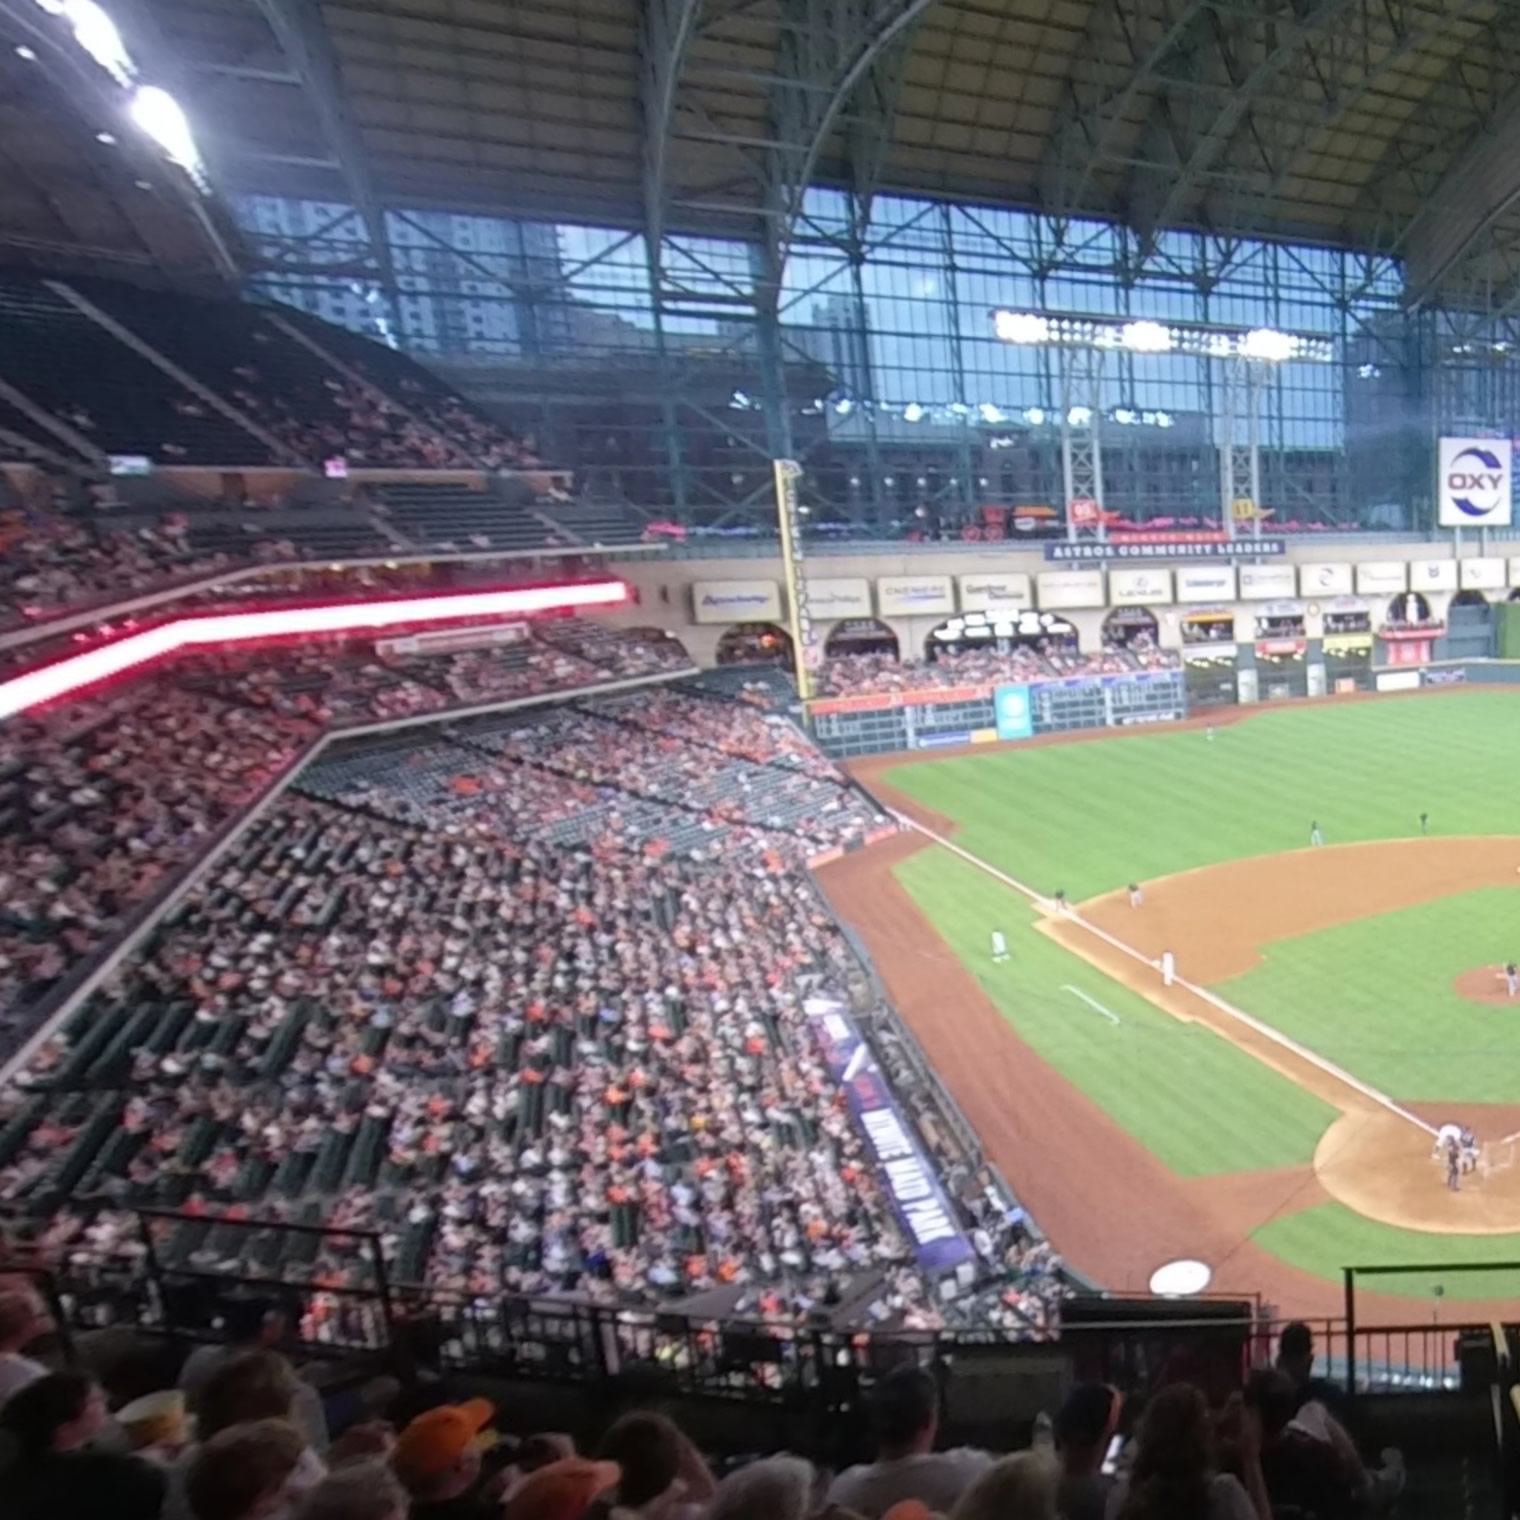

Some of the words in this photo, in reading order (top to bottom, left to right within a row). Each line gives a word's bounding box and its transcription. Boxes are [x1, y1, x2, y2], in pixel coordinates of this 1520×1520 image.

[1448, 472, 1504, 492] OXY
[1053, 545, 1115, 559] ASTROS
[1118, 543, 1213, 557] COMMUNITY
[1217, 541, 1280, 555] LEADERS
[861, 1107, 913, 1161] MINUTE
[884, 1159, 931, 1201] MAID
[900, 1197, 956, 1245] PARK
